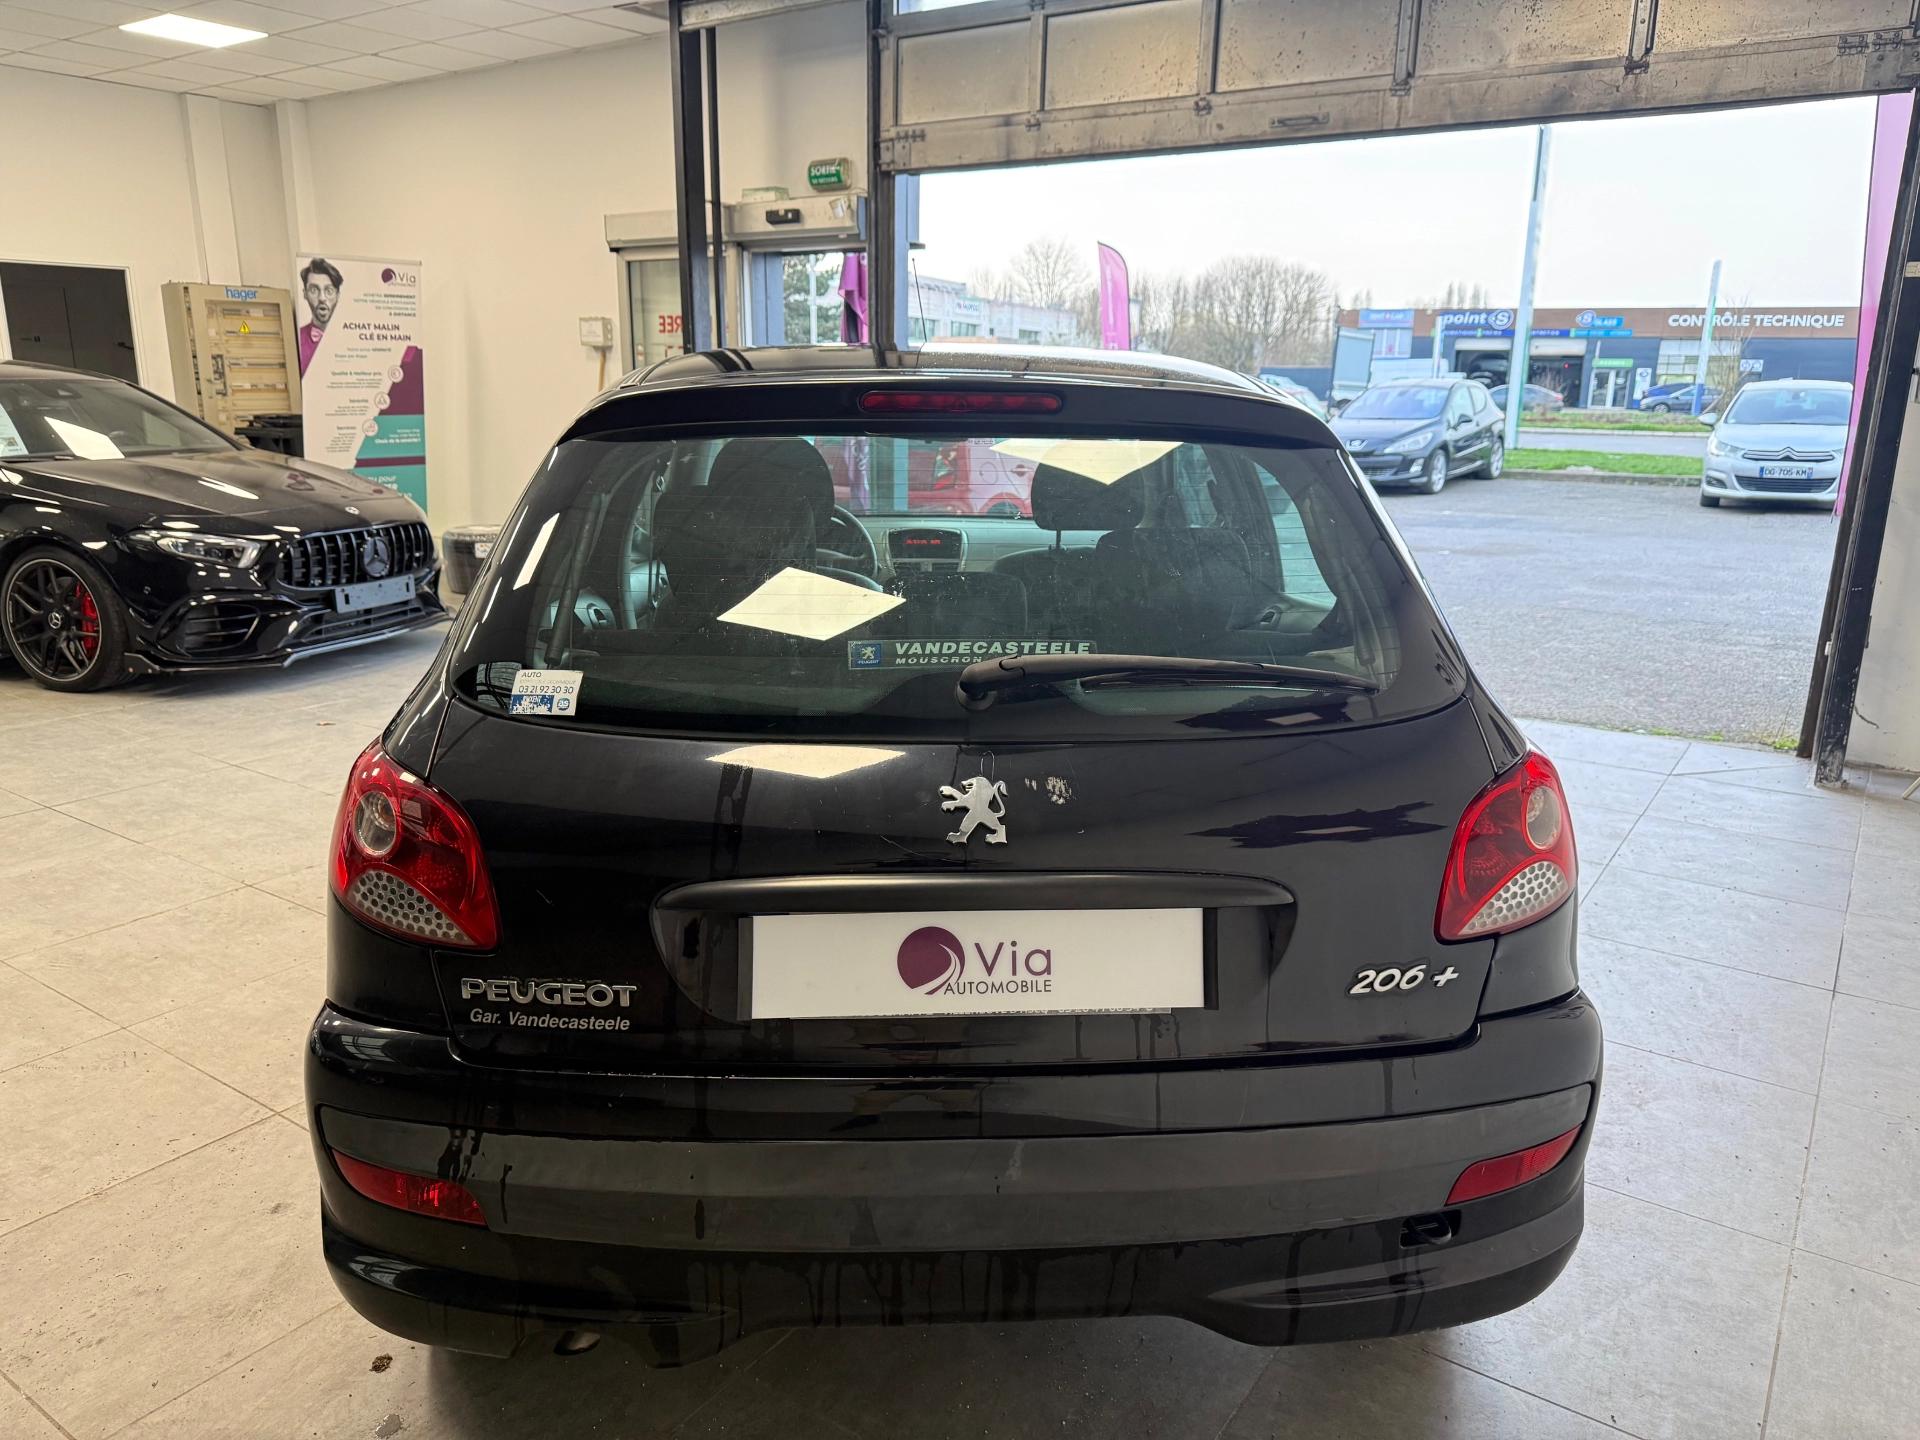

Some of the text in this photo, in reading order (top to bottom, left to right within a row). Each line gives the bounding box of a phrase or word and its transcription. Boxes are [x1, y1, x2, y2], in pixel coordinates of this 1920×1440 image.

[225, 286, 258, 301] hager
[1443, 312, 1487, 326] point
[343, 322, 400, 331] ACHAT MALIN
[358, 332, 375, 341] CLÉ
[389, 334, 411, 342] MAIN
[895, 641, 1090, 655] VANDECASTEELE
[895, 656, 982, 665] MOUSCRON
[518, 685, 574, 694] 03 21 92 30 30
[974, 940, 1052, 977] Via
[1349, 964, 1427, 994] 206
[461, 977, 637, 1007] PEUGEOT
[943, 979, 1052, 995] AUTOMOBILE
[470, 1008, 630, 1031] Gar. Vandecasteele
